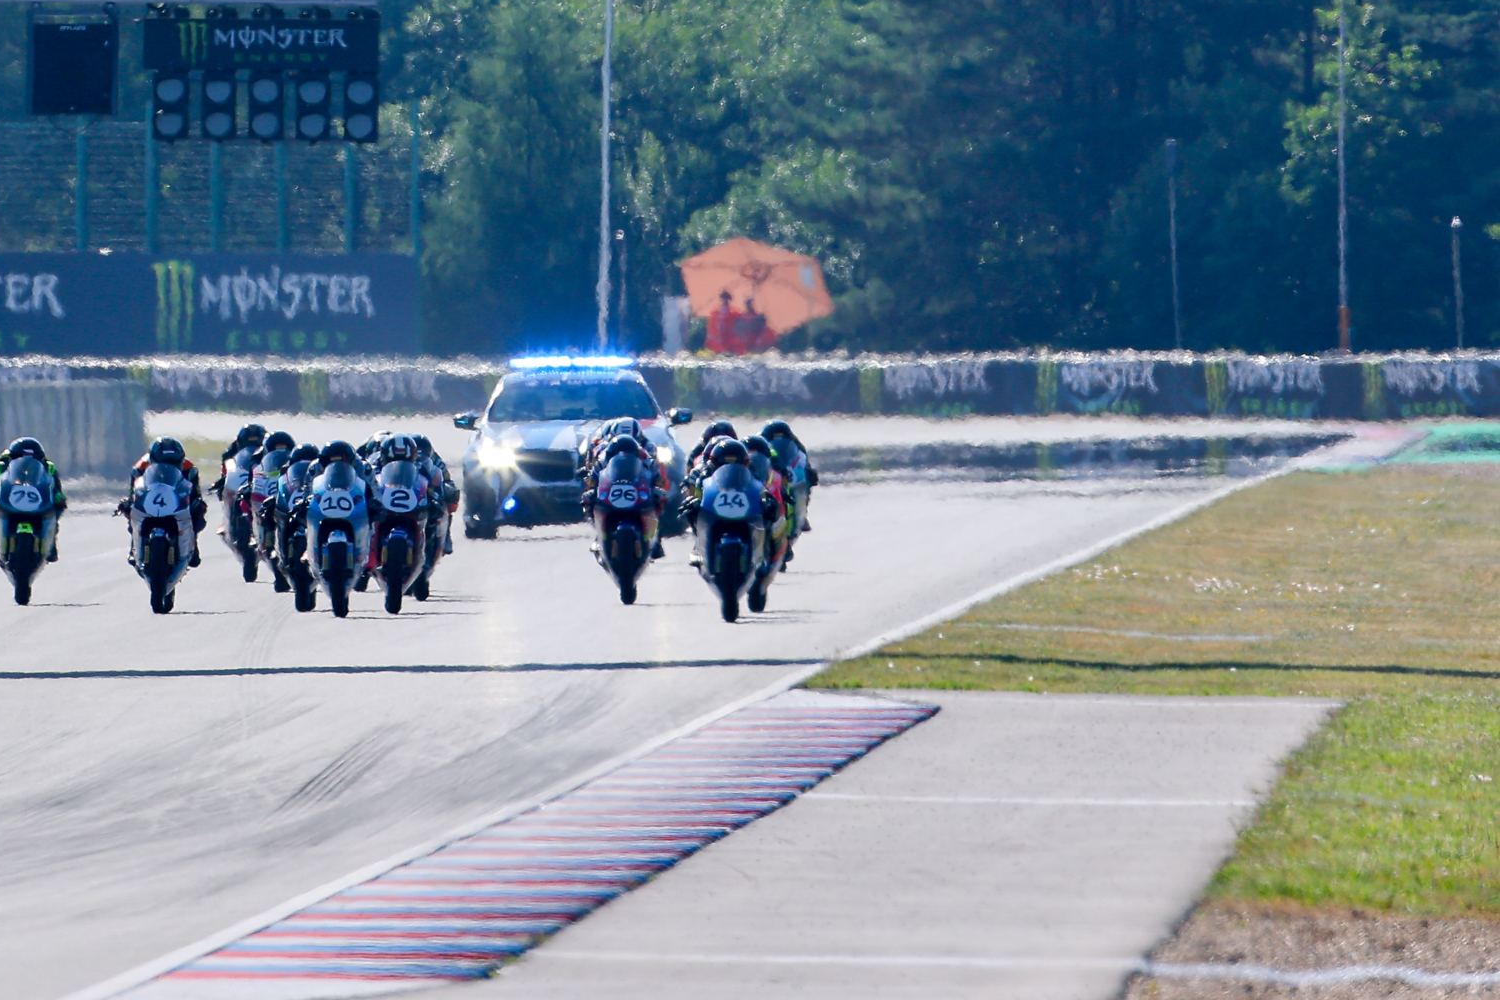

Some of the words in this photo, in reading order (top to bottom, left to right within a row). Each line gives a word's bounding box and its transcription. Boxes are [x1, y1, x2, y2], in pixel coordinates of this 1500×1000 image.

[213, 25, 348, 49] MONSTER
[201, 266, 376, 322] MONSTER
[152, 493, 167, 507] 4
[390, 489, 411, 509] 2
[610, 488, 637, 502] 96
[717, 493, 746, 509] 14
[322, 496, 353, 511] 10
